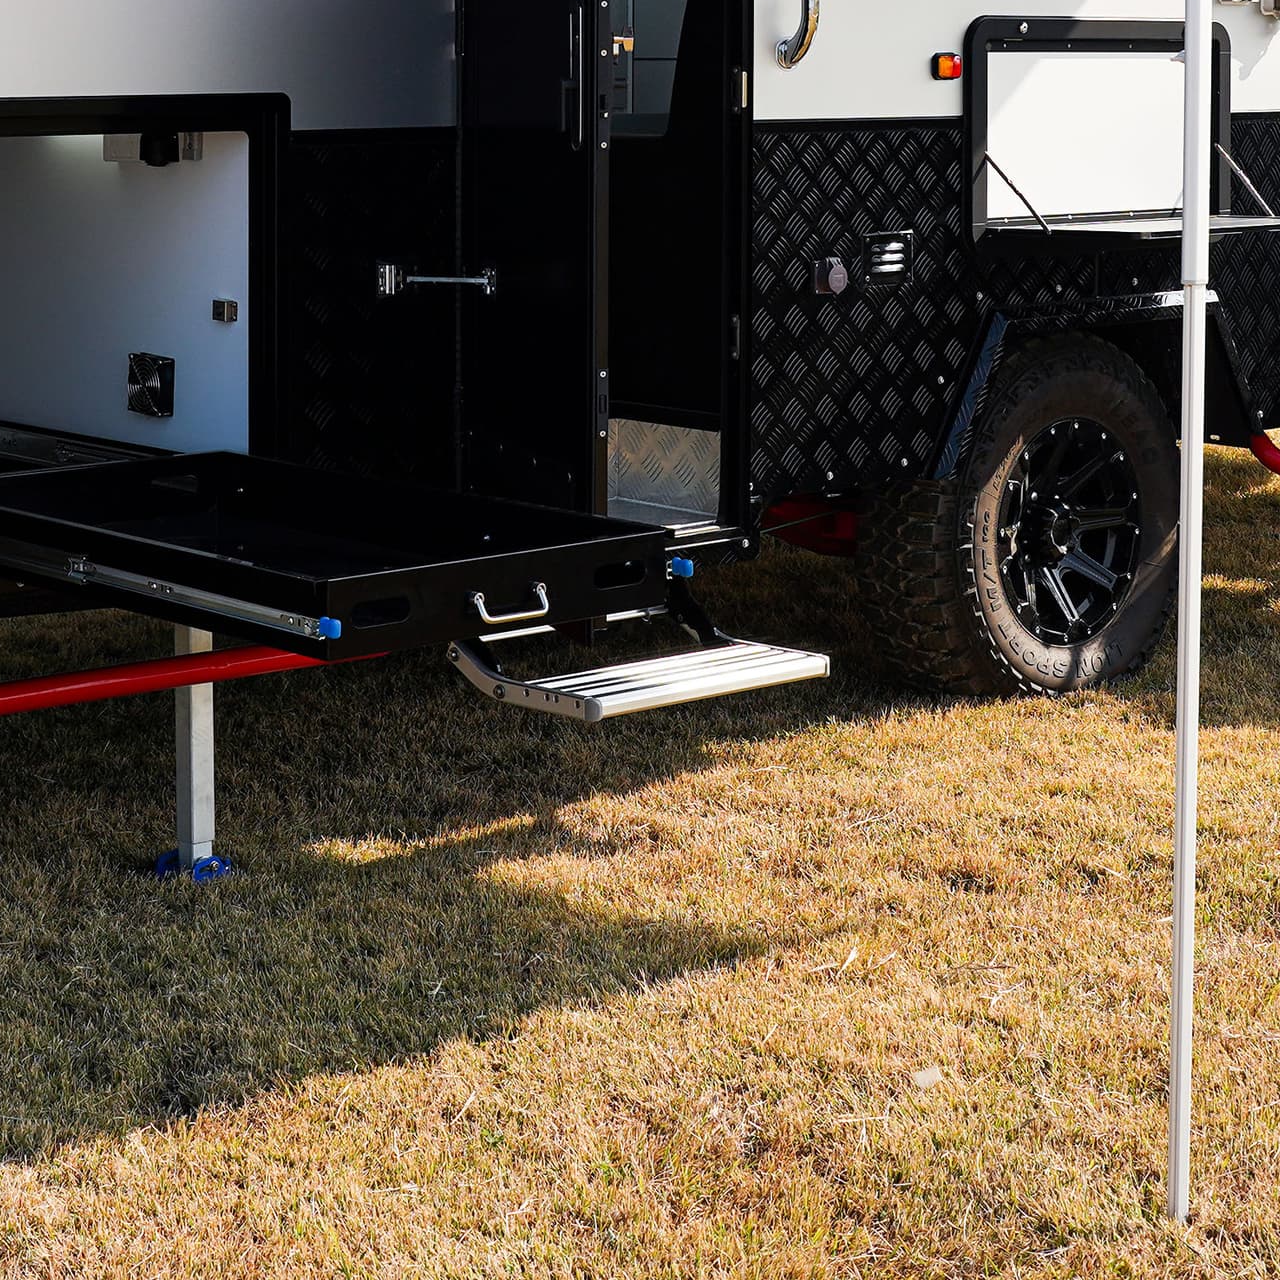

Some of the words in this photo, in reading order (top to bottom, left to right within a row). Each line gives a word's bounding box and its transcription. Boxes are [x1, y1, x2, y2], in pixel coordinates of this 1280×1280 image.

[981, 549, 1001, 612] M/T
[998, 617, 1068, 678] SPORT
[1075, 641, 1124, 678] LION
